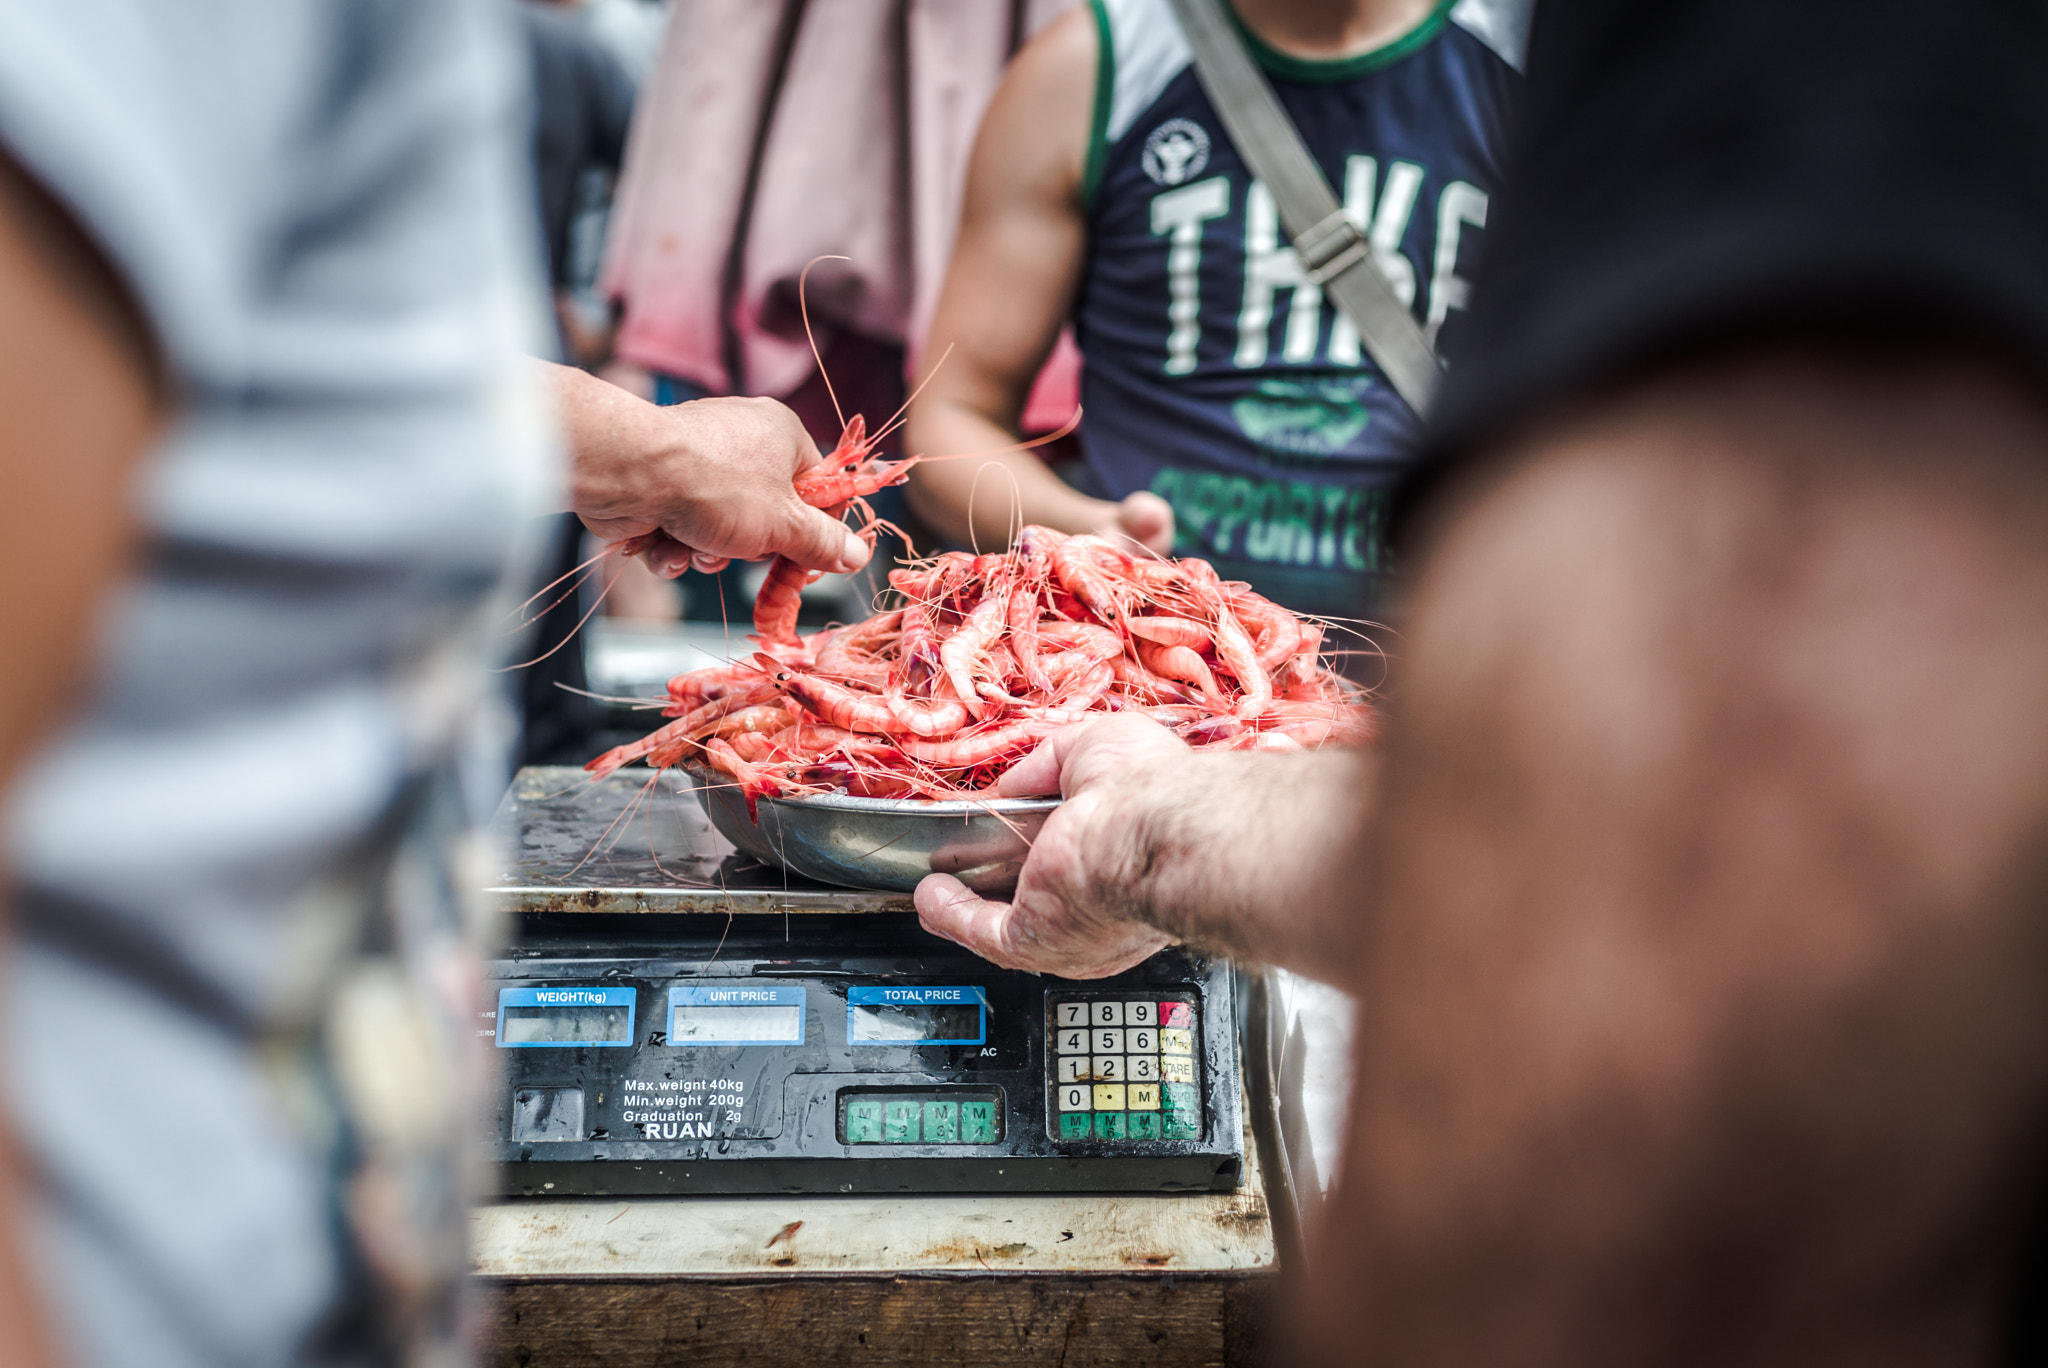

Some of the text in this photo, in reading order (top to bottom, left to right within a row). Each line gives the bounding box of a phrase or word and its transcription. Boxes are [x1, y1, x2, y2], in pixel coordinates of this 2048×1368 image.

[536, 992, 606, 1004] WEIGHT(kg)
[710, 991, 777, 1001] UNIT PRICE
[884, 990, 960, 1000] TOTAL PRICE
[1067, 1006, 1079, 1022] 7
[1102, 1006, 1113, 1021] 8
[1136, 1006, 1147, 1021] 9
[1068, 1033, 1080, 1049] 4
[1102, 1033, 1114, 1048] 5
[1137, 1032, 1148, 1048] 6
[980, 1047, 997, 1056] AC
[1070, 1060, 1190, 1078] 1 2 3 TARE
[709, 1079, 744, 1092] 40kg
[623, 1094, 744, 1108] Min.weight 200g
[1069, 1089, 1081, 1106] 0
[1138, 1091, 1151, 1102] M
[622, 1110, 742, 1122] Graduation 2g
[859, 1107, 872, 1119] M
[935, 1107, 948, 1119] M
[973, 1107, 986, 1119] M
[1070, 1115, 1151, 1127] M M M
[645, 1122, 713, 1139] RUAN
[936, 1125, 946, 1137] 3
[1107, 1127, 1115, 1138] 6
